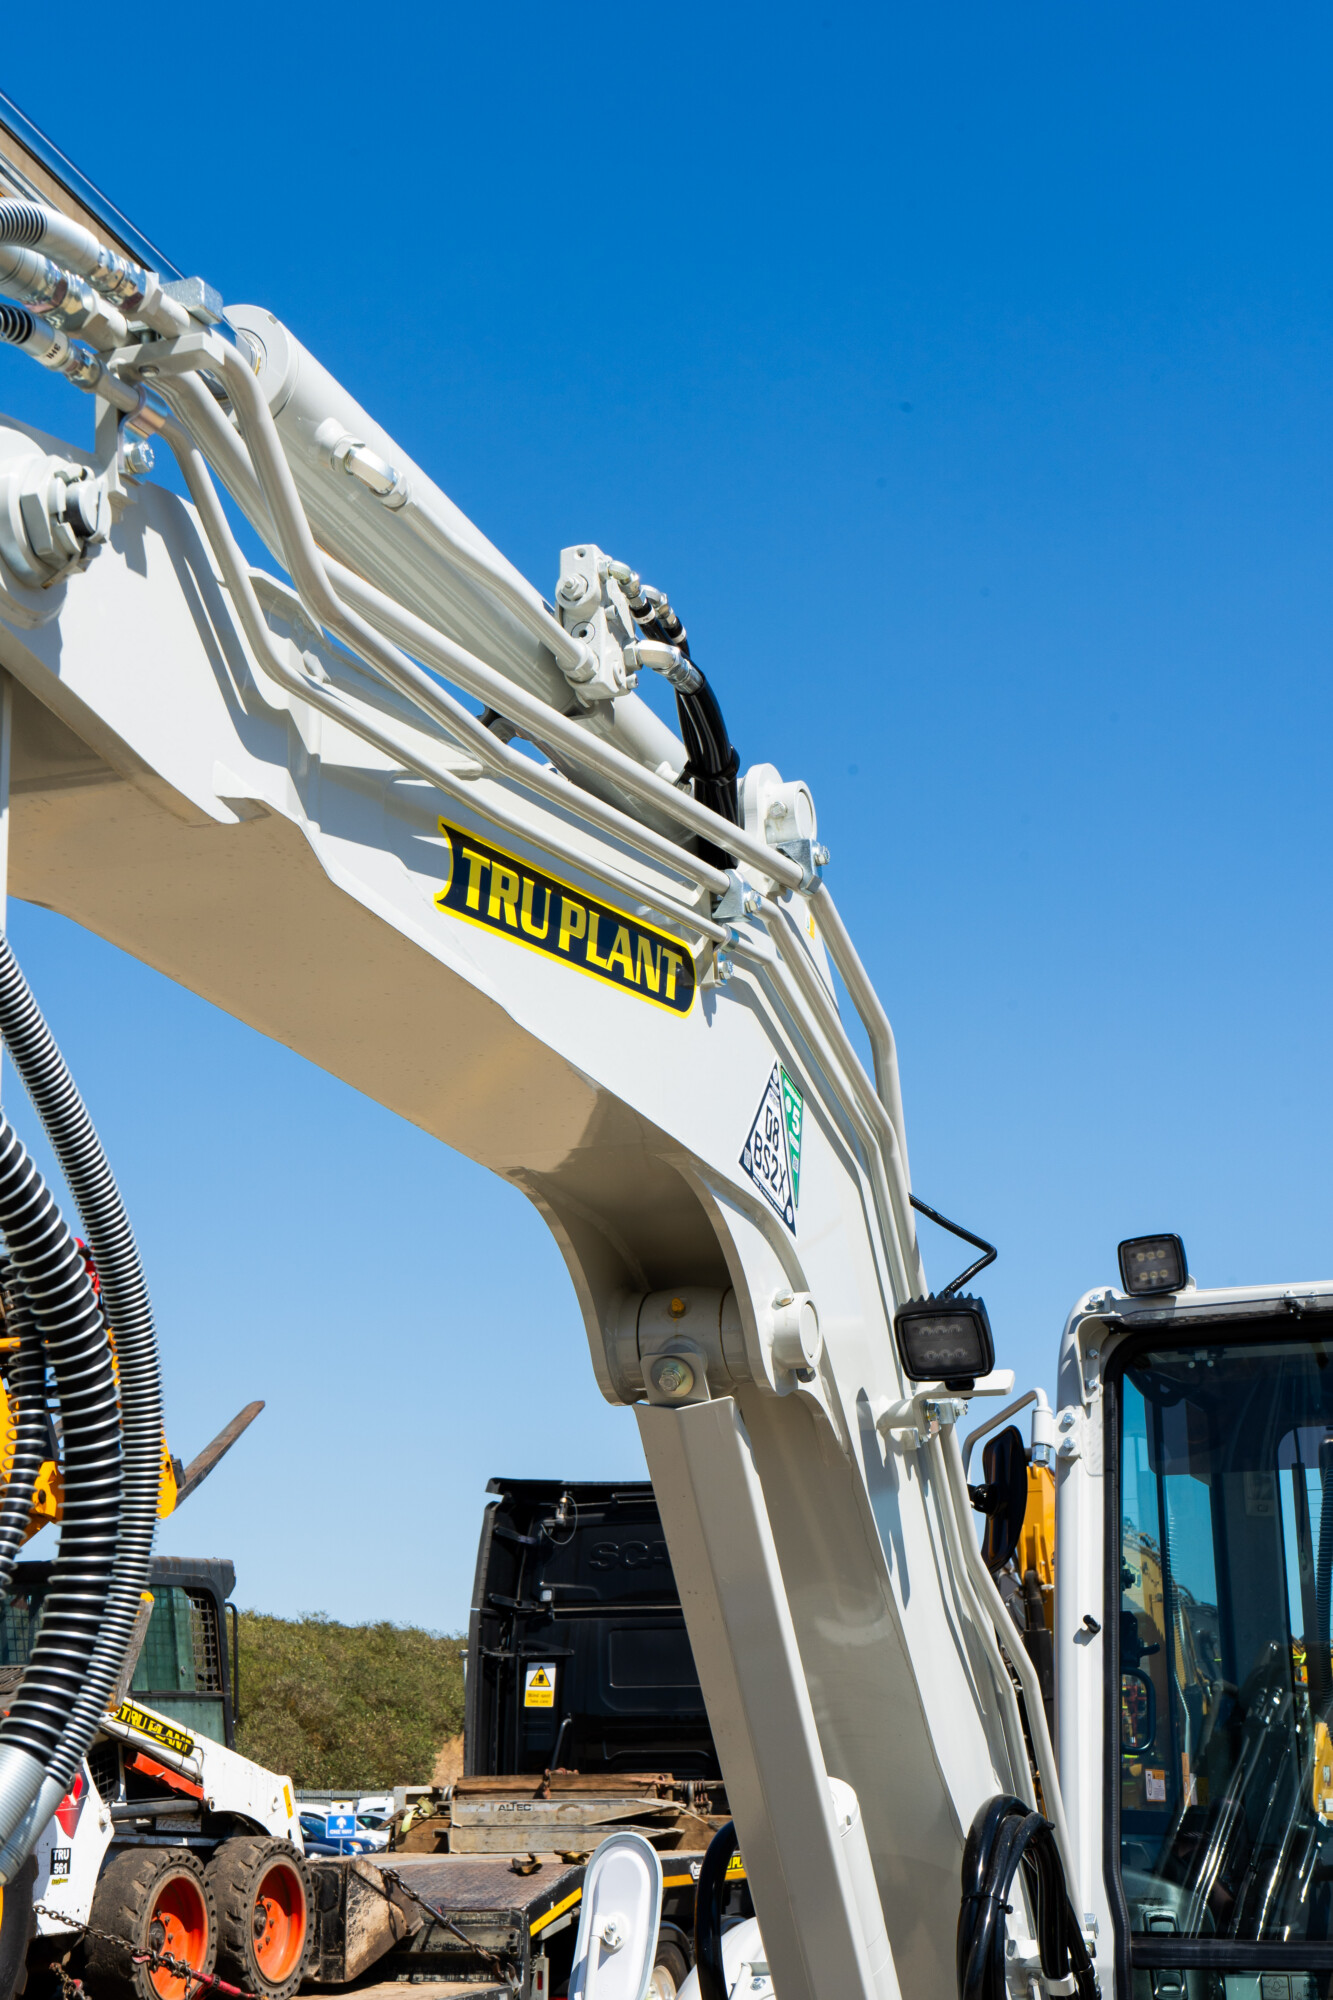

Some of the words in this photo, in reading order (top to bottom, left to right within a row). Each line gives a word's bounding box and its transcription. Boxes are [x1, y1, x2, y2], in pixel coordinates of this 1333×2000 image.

[461, 846, 551, 940] TRU
[558, 896, 682, 1000] PLANT
[792, 1104, 800, 1136] 5
[754, 1130, 786, 1203] BS2X
[588, 1540, 672, 1570] SCA
[121, 1705, 148, 1729] TRU
[148, 1720, 191, 1753] PLANT
[498, 1802, 531, 1811] ALTEC
[53, 1849, 69, 1860] TRU
[53, 1863, 68, 1875] 561
